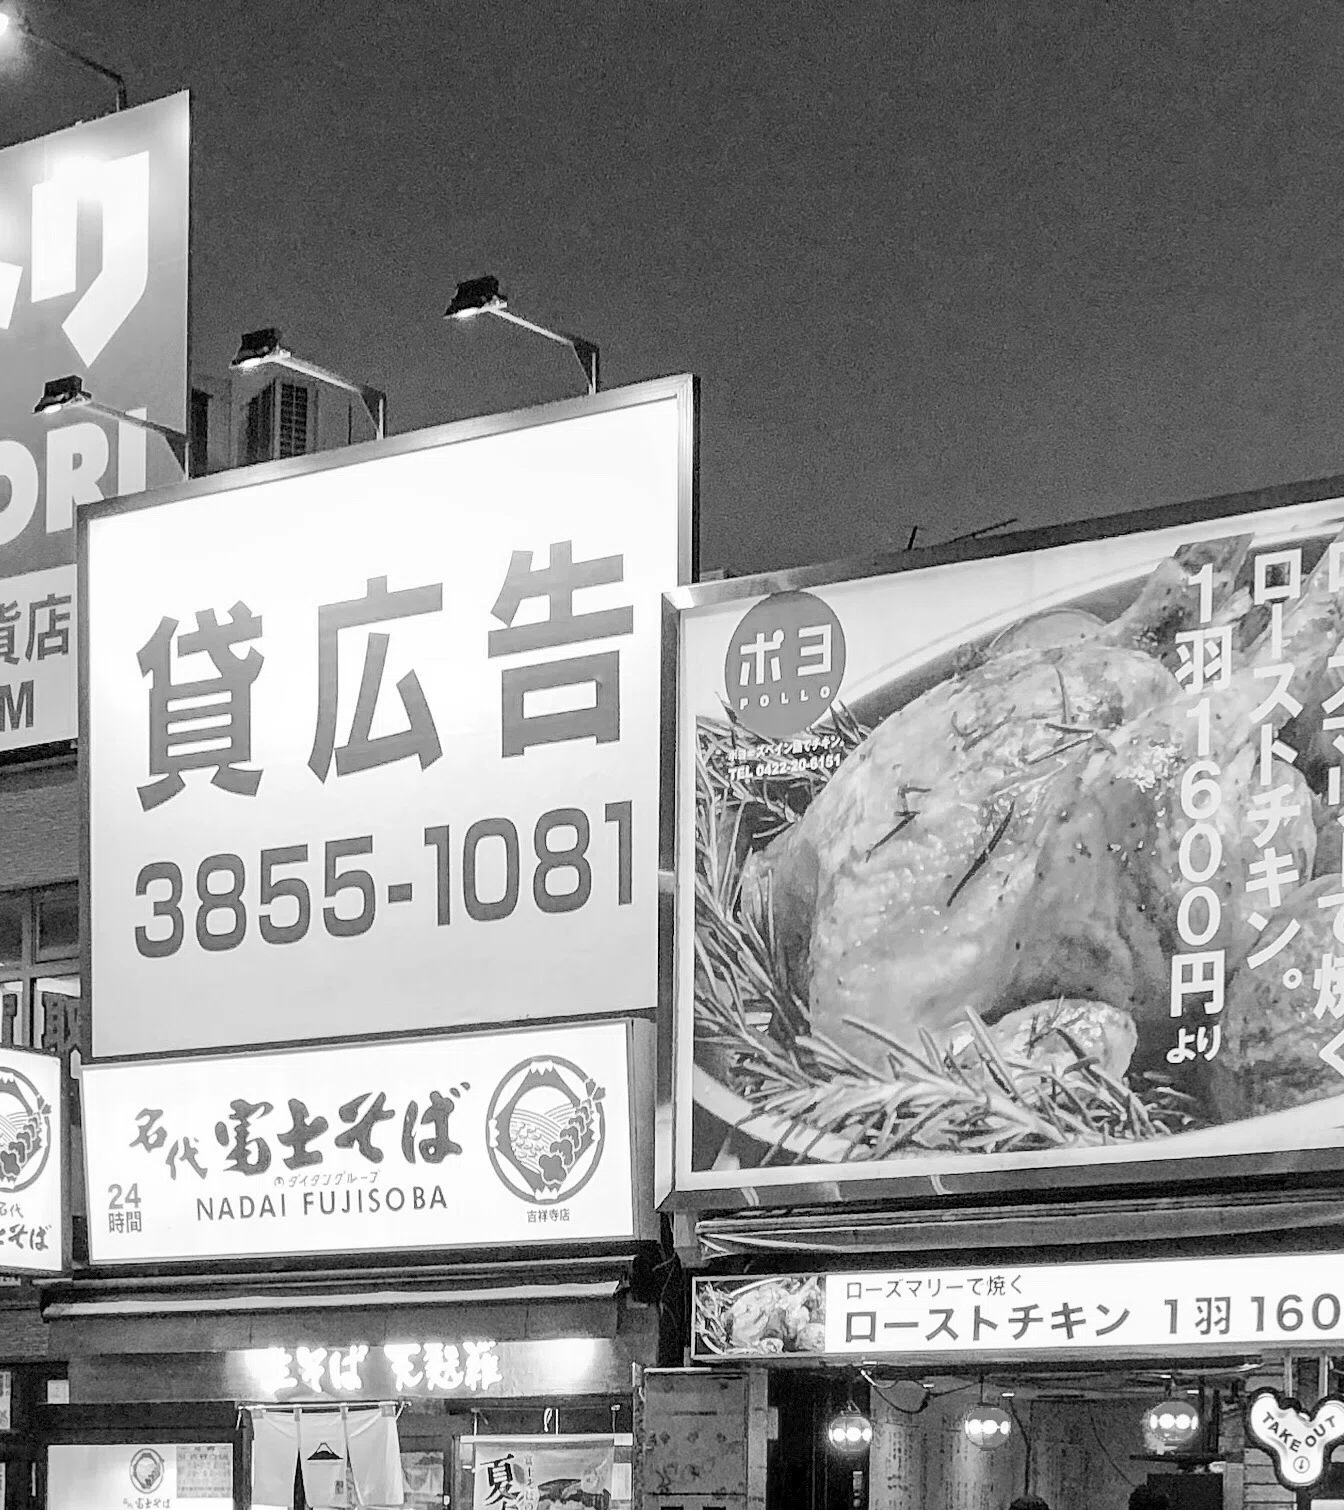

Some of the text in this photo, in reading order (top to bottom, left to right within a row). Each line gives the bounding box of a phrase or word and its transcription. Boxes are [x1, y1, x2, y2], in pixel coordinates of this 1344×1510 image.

[739, 623, 832, 687] ポヨ
[135, 540, 635, 813] 貸広告
[739, 685, 831, 711] POLLO
[727, 766, 754, 781] TEL
[134, 800, 634, 960] 3855-1081
[108, 1183, 142, 1210] 24
[196, 1184, 449, 1222] NADAI FUJISOBA
[108, 1211, 143, 1234] 時間
[526, 1208, 571, 1224] 吉祥寺店
[846, 1274, 1023, 1300] ローズマリーで焼く
[845, 1301, 1131, 1343] ローストチキン
[1262, 1411, 1302, 1453] TAKE
[1305, 1415, 1337, 1448] OUT
